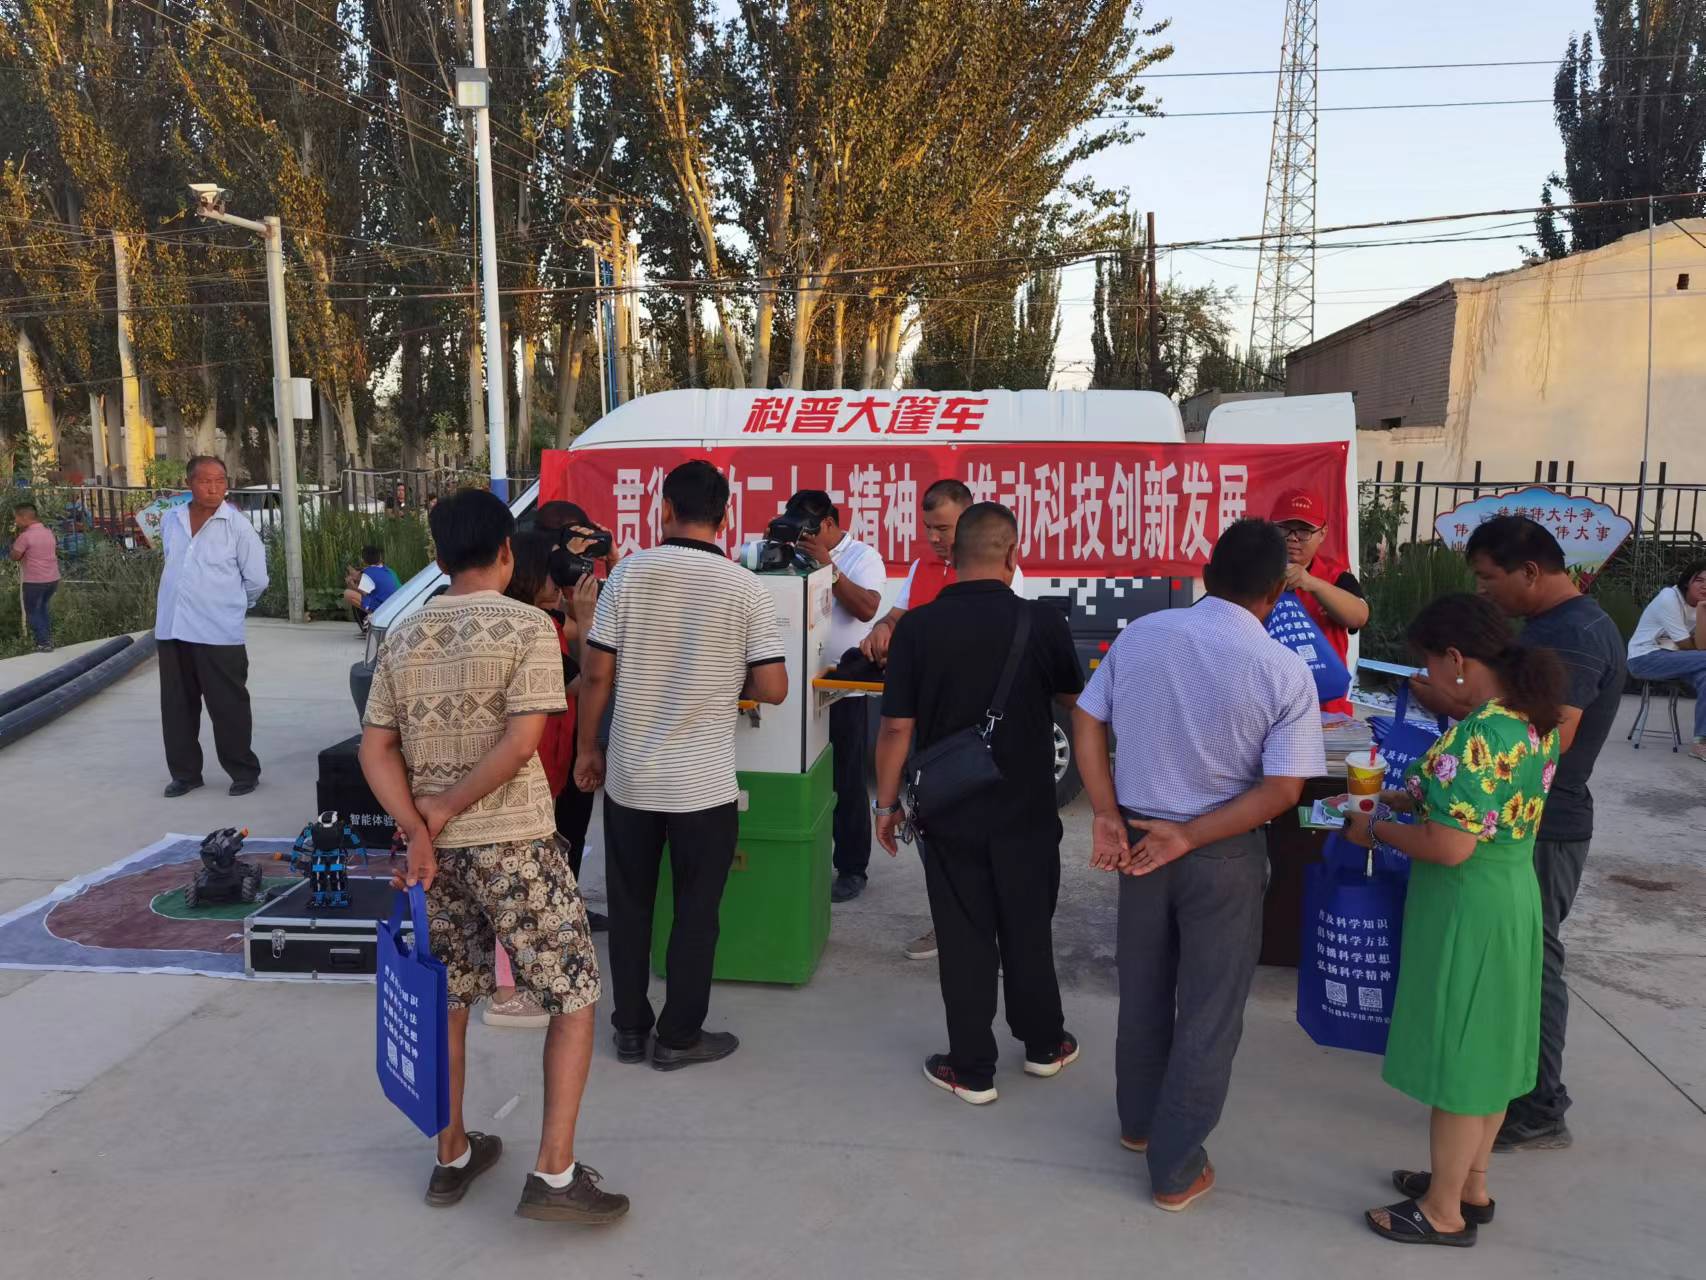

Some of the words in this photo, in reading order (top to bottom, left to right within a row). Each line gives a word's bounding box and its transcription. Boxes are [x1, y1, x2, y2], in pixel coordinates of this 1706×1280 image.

[742, 396, 989, 434] 科普大篷车
